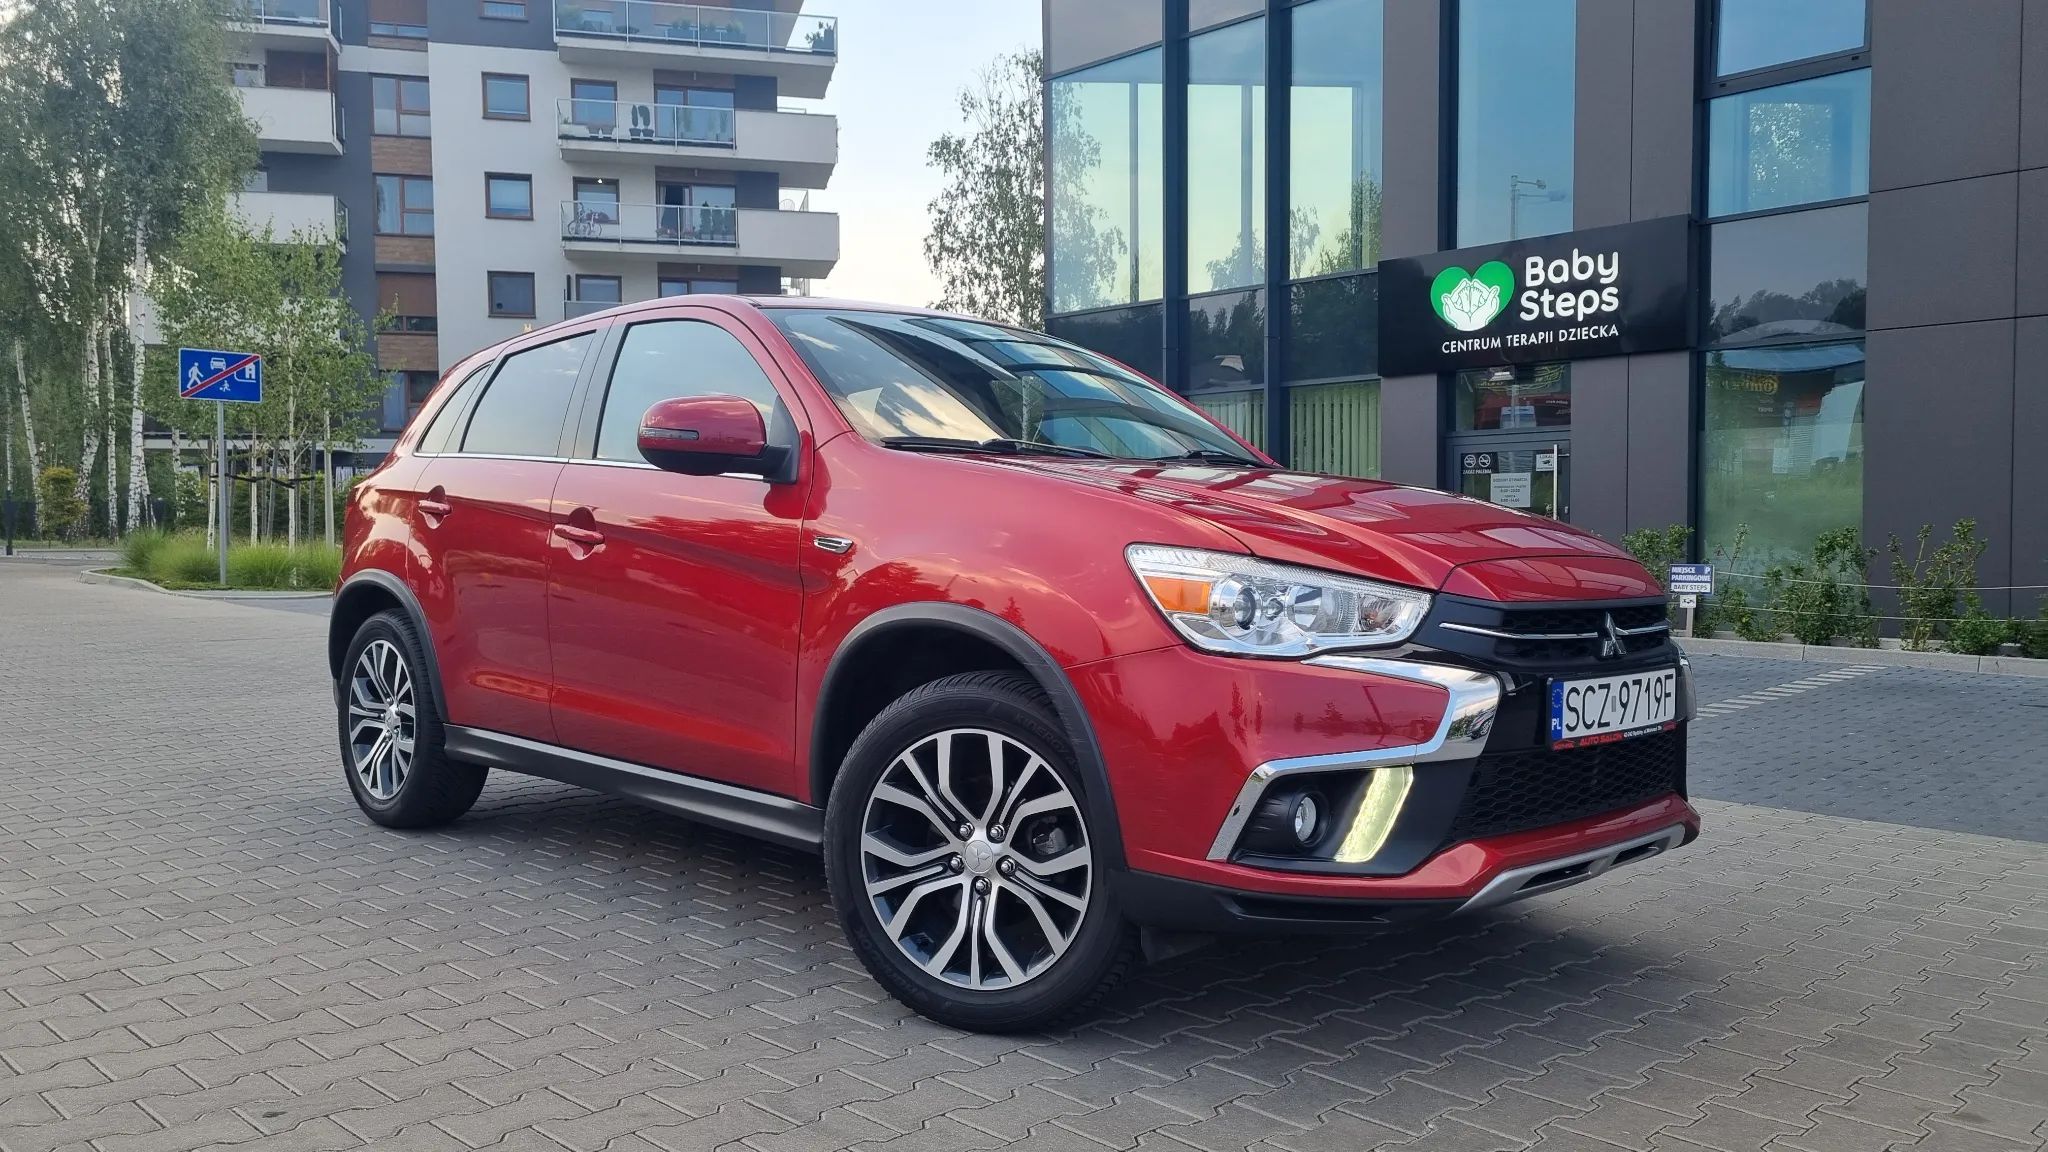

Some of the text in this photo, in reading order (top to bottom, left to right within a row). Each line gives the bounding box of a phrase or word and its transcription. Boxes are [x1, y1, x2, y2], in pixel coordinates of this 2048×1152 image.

[1525, 248, 1619, 287] Baby
[1519, 286, 1619, 322] Steps
[1441, 324, 1619, 354] CENTRUM TERAPII DZIECKA
[1671, 566, 1695, 574] MIEJSCE
[1565, 674, 1673, 732] SCZ 9719F
[1551, 717, 1562, 731] PL
[1579, 735, 1599, 747] AUTO
